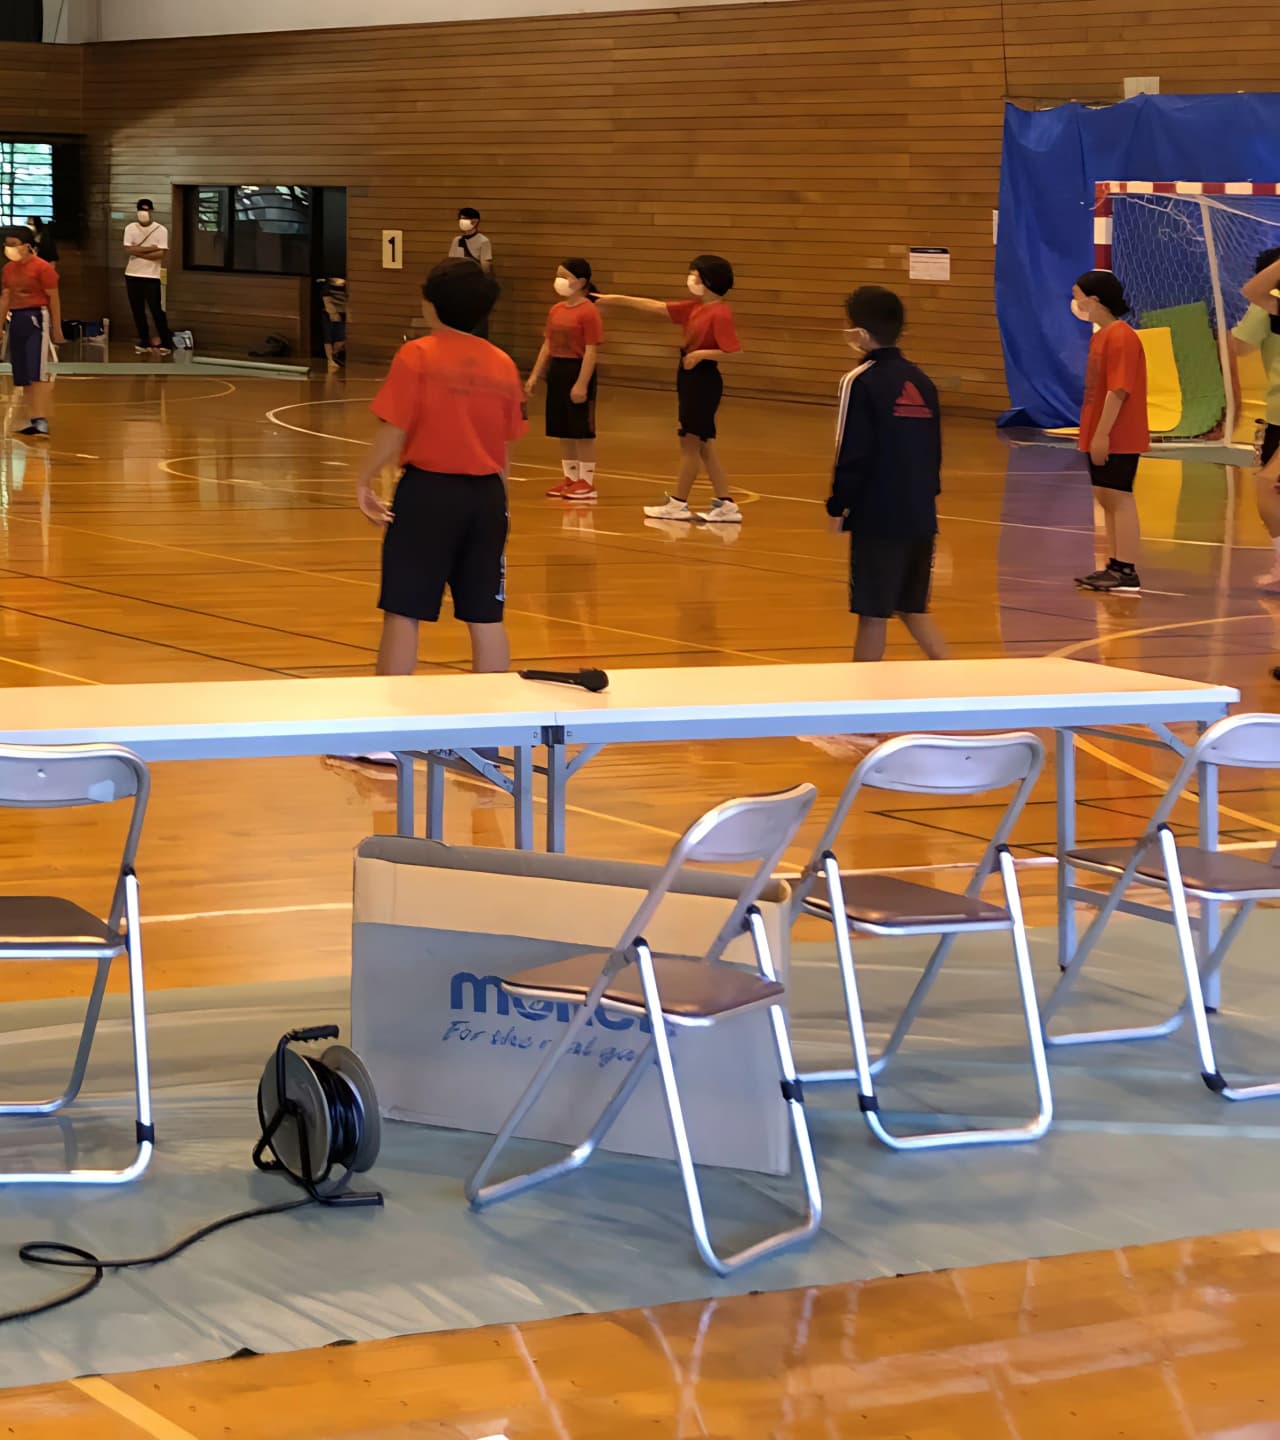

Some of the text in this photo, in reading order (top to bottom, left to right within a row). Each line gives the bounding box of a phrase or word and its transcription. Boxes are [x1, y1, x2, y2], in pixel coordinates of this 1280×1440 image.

[387, 236, 396, 263] 1
[442, 1020, 486, 1042] For
[538, 1036, 598, 1057] ral
